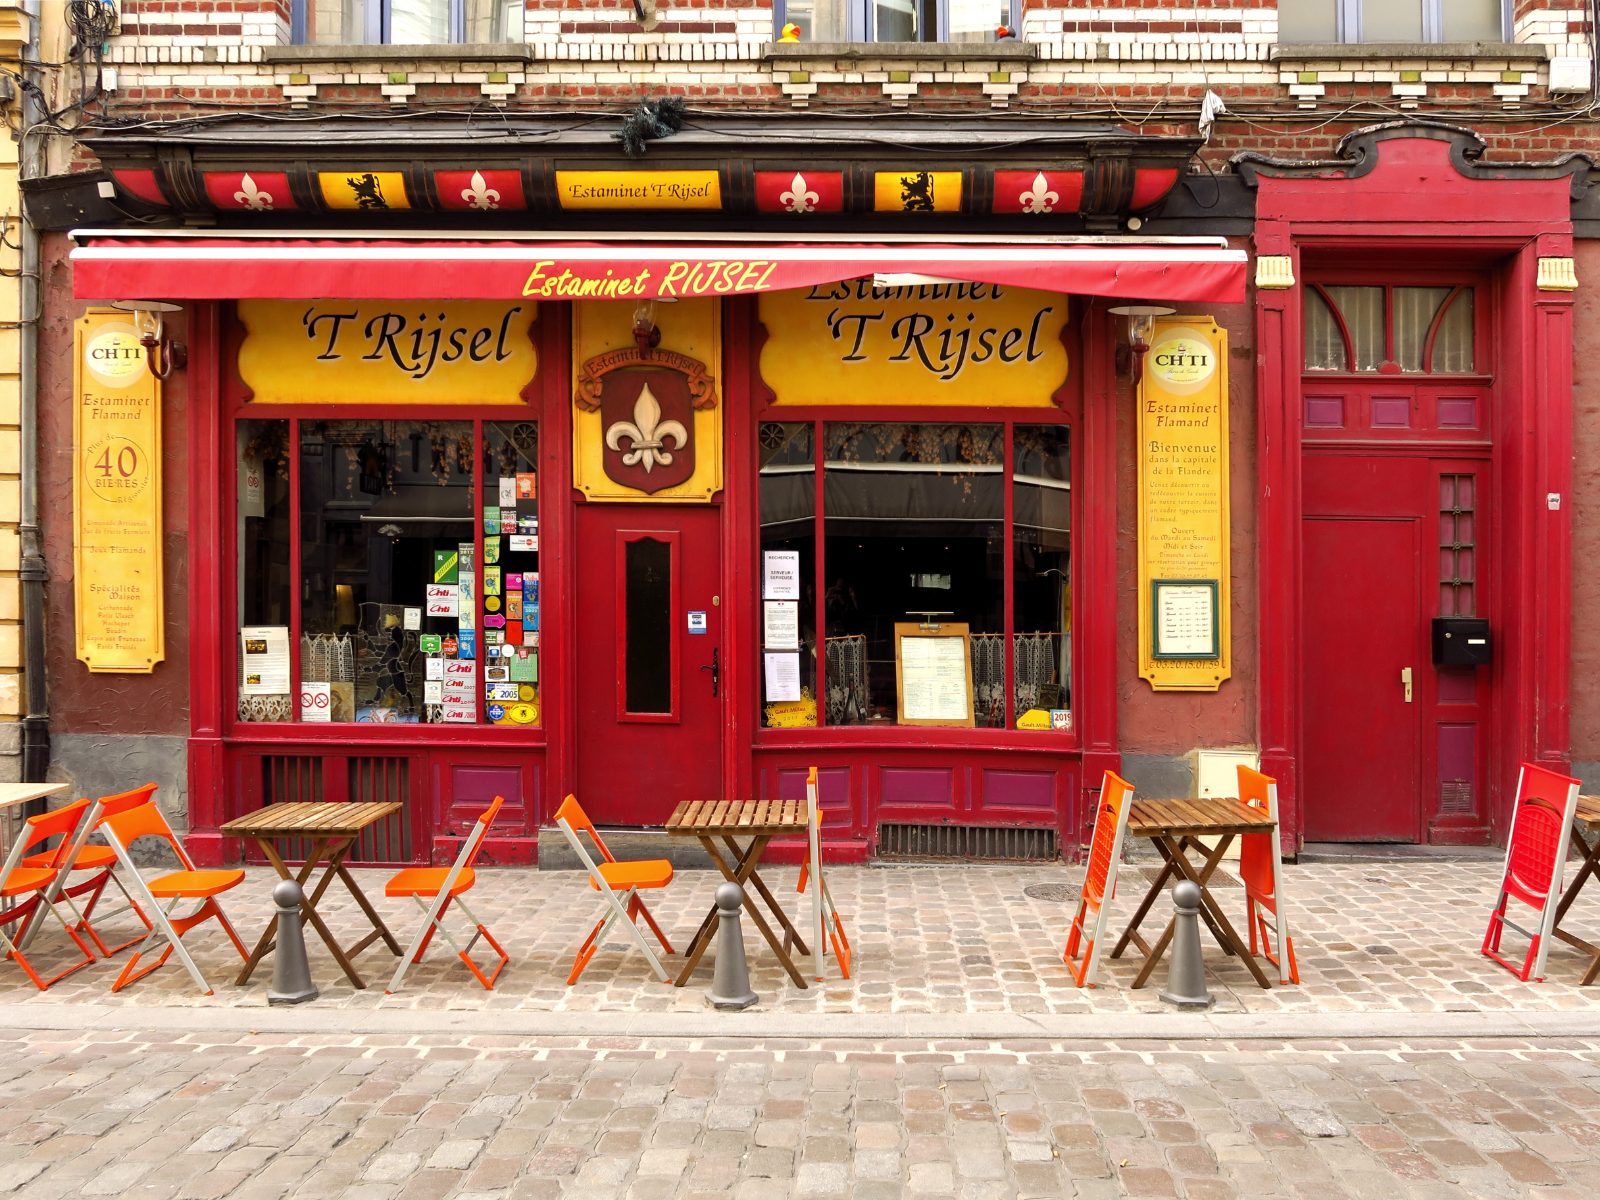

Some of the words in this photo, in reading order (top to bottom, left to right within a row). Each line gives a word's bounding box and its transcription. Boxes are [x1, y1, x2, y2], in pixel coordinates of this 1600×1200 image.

[568, 183, 647, 198] Estaminet
[667, 181, 712, 201] Rijsel
[522, 260, 651, 298] Estaminet
[657, 260, 778, 297] RIJSEL
[362, 306, 523, 379] Rijsel
[888, 306, 1053, 380] Rijsel
[83, 393, 150, 406] Estaminet
[1146, 400, 1218, 414] Estaminet
[92, 408, 141, 420] Flamand
[1156, 416, 1209, 427] Flamand
[1148, 440, 1217, 453] Bienvenue
[94, 446, 138, 478] 40
[1149, 455, 1169, 463] dans
[1172, 455, 1180, 463] la
[1183, 455, 1217, 466] capitale
[1152, 467, 1162, 475] de
[1166, 467, 1174, 475] la
[89, 584, 140, 594] Spécialités
[500, 690, 518, 699] 2005
[1054, 713, 1072, 722] 2019
